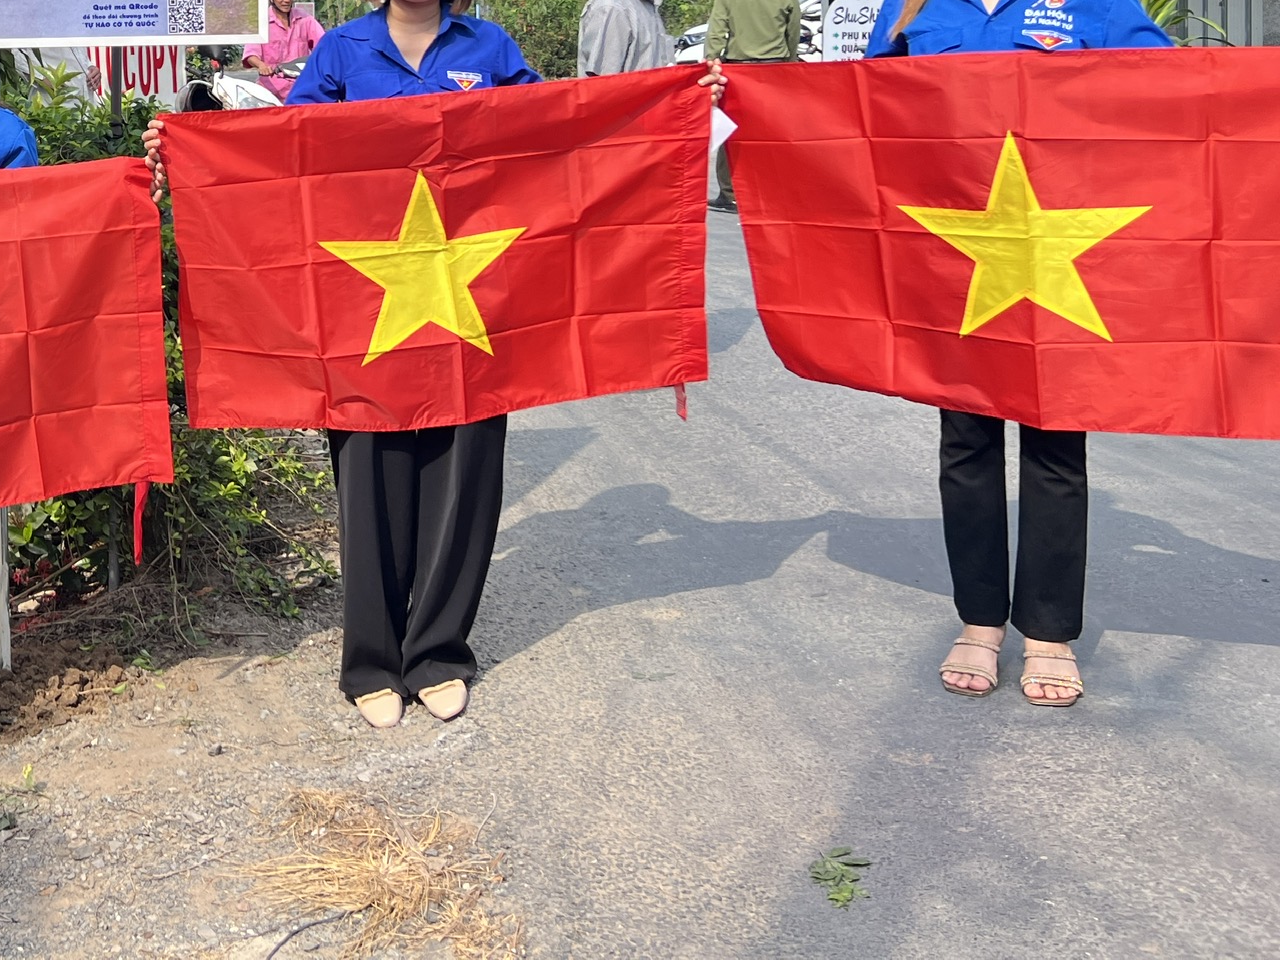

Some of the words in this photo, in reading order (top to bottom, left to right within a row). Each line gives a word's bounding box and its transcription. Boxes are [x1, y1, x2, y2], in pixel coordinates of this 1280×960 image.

[128, 2, 159, 10] QRcode
[112, 20, 122, 28] CỜ
[841, 31, 859, 41] PHỤ
